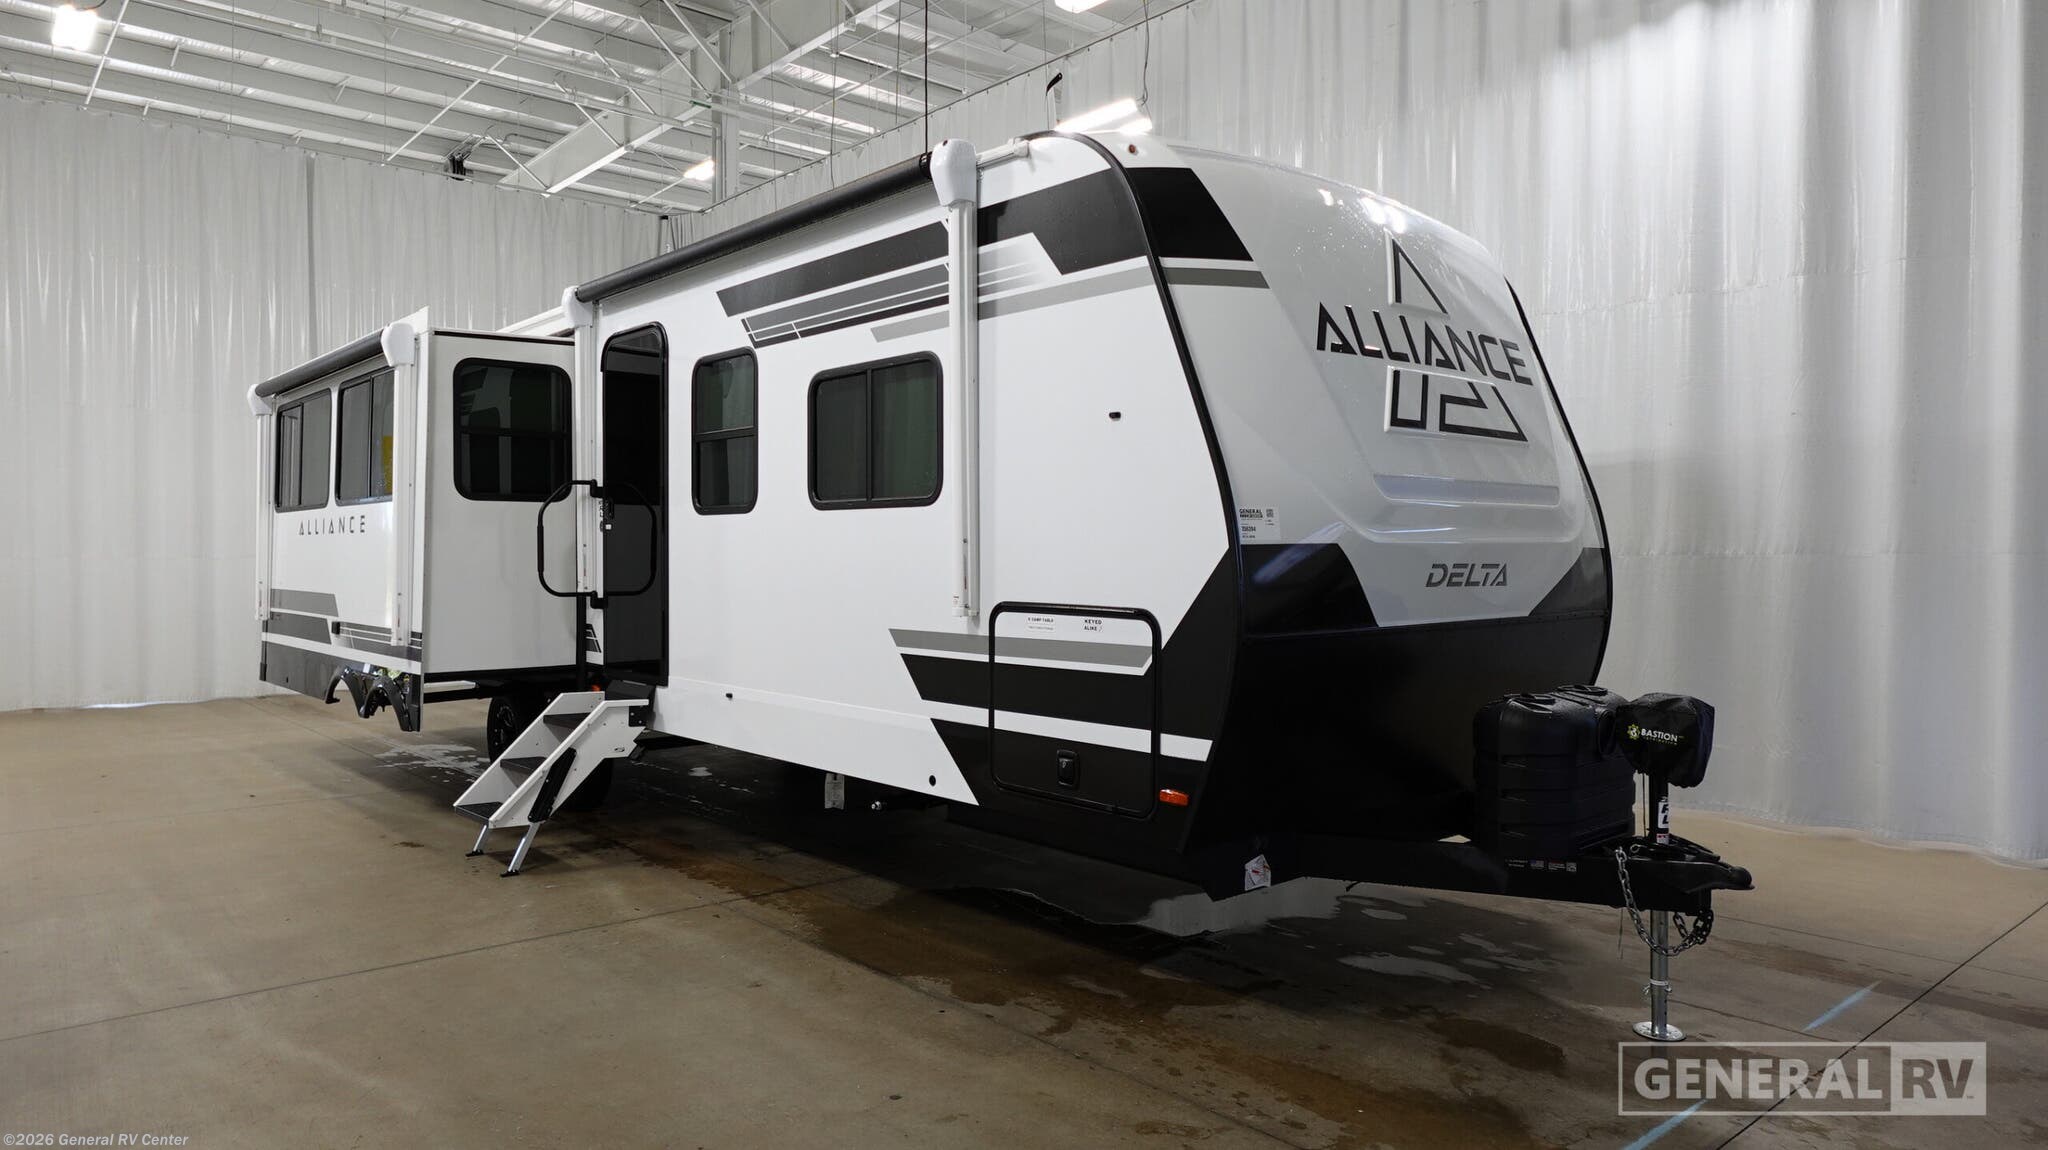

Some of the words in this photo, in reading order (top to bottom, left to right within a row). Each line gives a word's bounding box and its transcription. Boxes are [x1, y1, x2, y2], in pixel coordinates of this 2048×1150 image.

[1316, 302, 1533, 386] ALLIANCE
[299, 515, 366, 536] ALLIANCE
[1425, 563, 1507, 587] DELTA
[1641, 728, 1678, 742] BASTION
